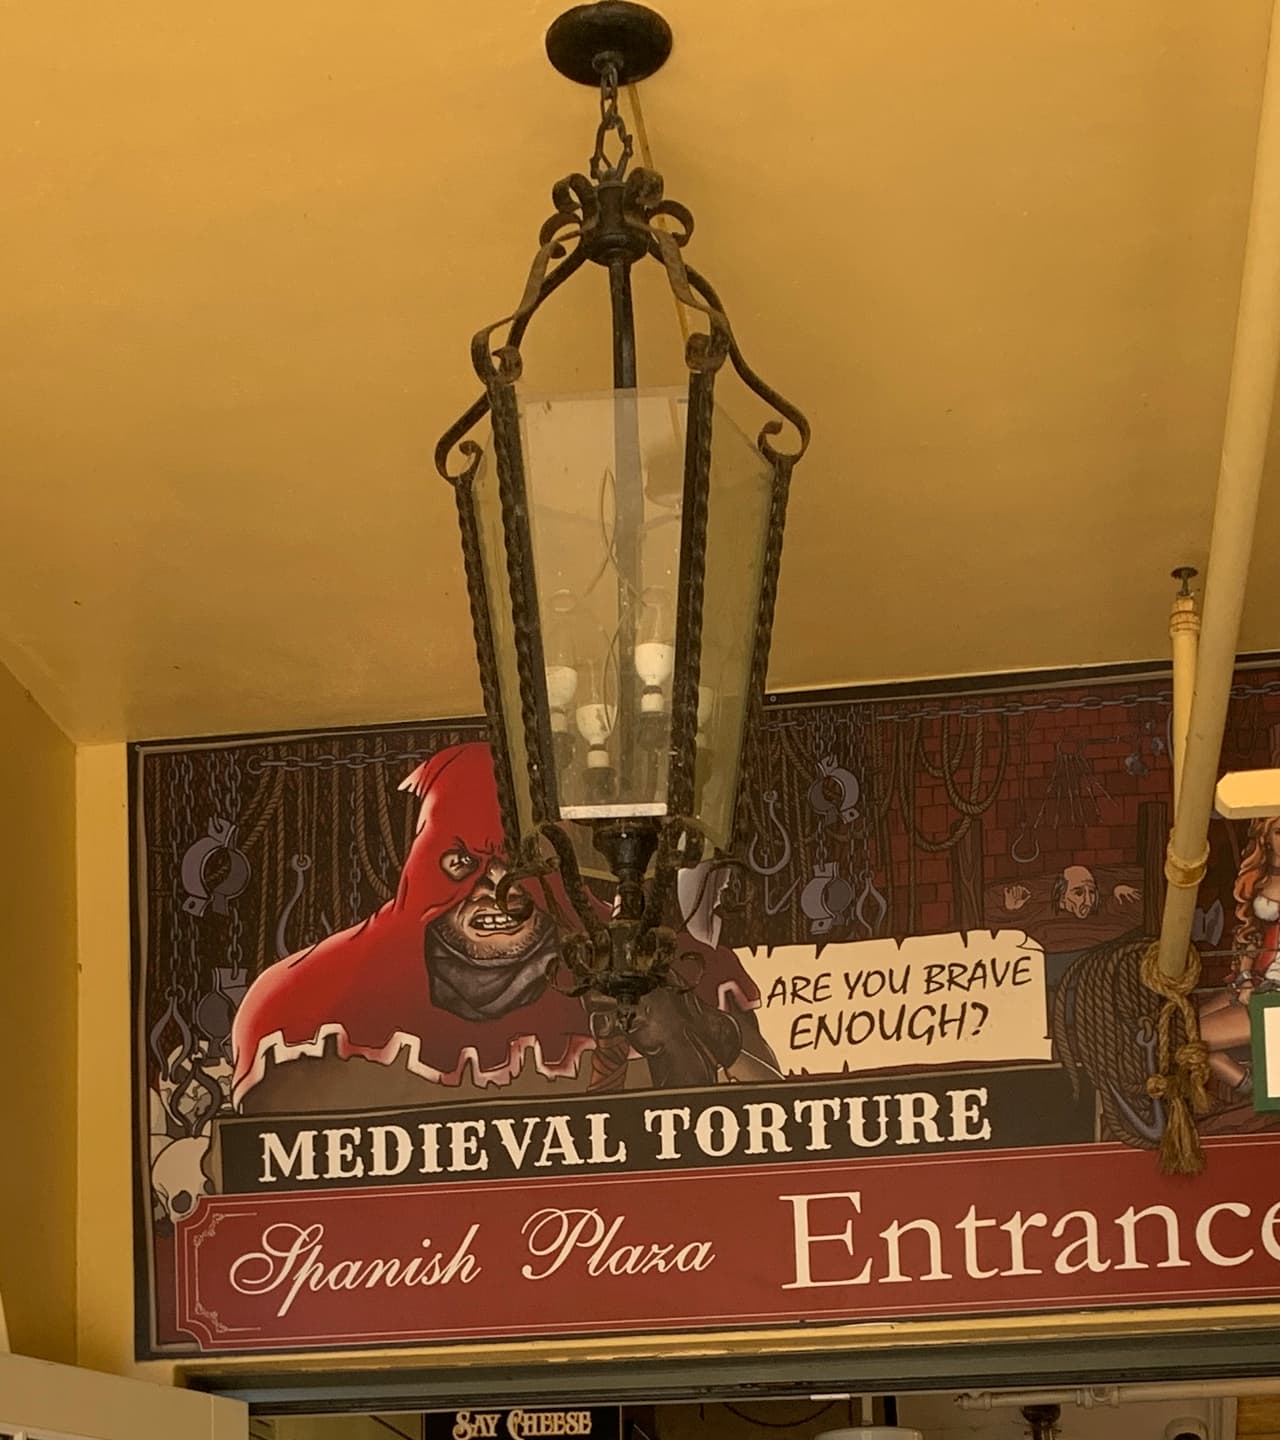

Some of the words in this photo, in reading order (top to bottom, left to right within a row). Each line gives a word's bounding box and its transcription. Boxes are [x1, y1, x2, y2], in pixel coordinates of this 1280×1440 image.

[767, 973, 832, 1008] ARE
[843, 964, 911, 1000] YOU
[923, 956, 1032, 995] BRAVE
[790, 1002, 989, 1050] ENOUGH?
[258, 1112, 627, 1183] MEDIEVAL
[644, 1087, 992, 1161] TORTURE
[229, 1222, 482, 1318] Spanish
[521, 1208, 717, 1280] Plaza
